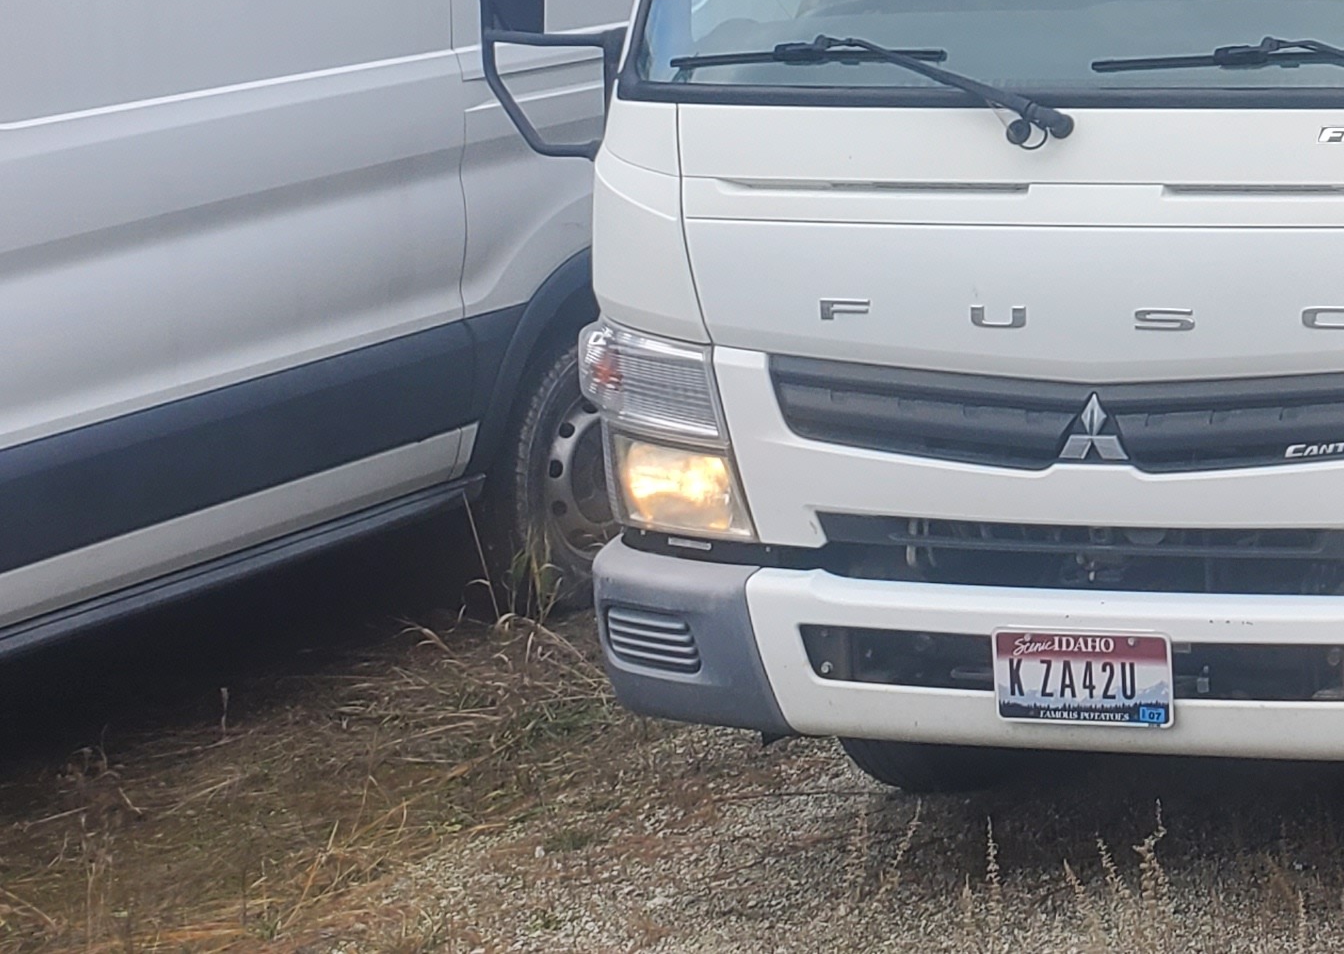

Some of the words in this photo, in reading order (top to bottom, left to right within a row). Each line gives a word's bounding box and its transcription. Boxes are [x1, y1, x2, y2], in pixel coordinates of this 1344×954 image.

[1013, 635, 1056, 657] Scenic
[1053, 635, 1115, 653] IDAHO
[1008, 657, 1025, 698] K
[1039, 658, 1137, 701] ZA42U
[1039, 708, 1078, 720] FAMOUS
[1080, 710, 1130, 722] POTATOES
[1148, 711, 1162, 721] 07
